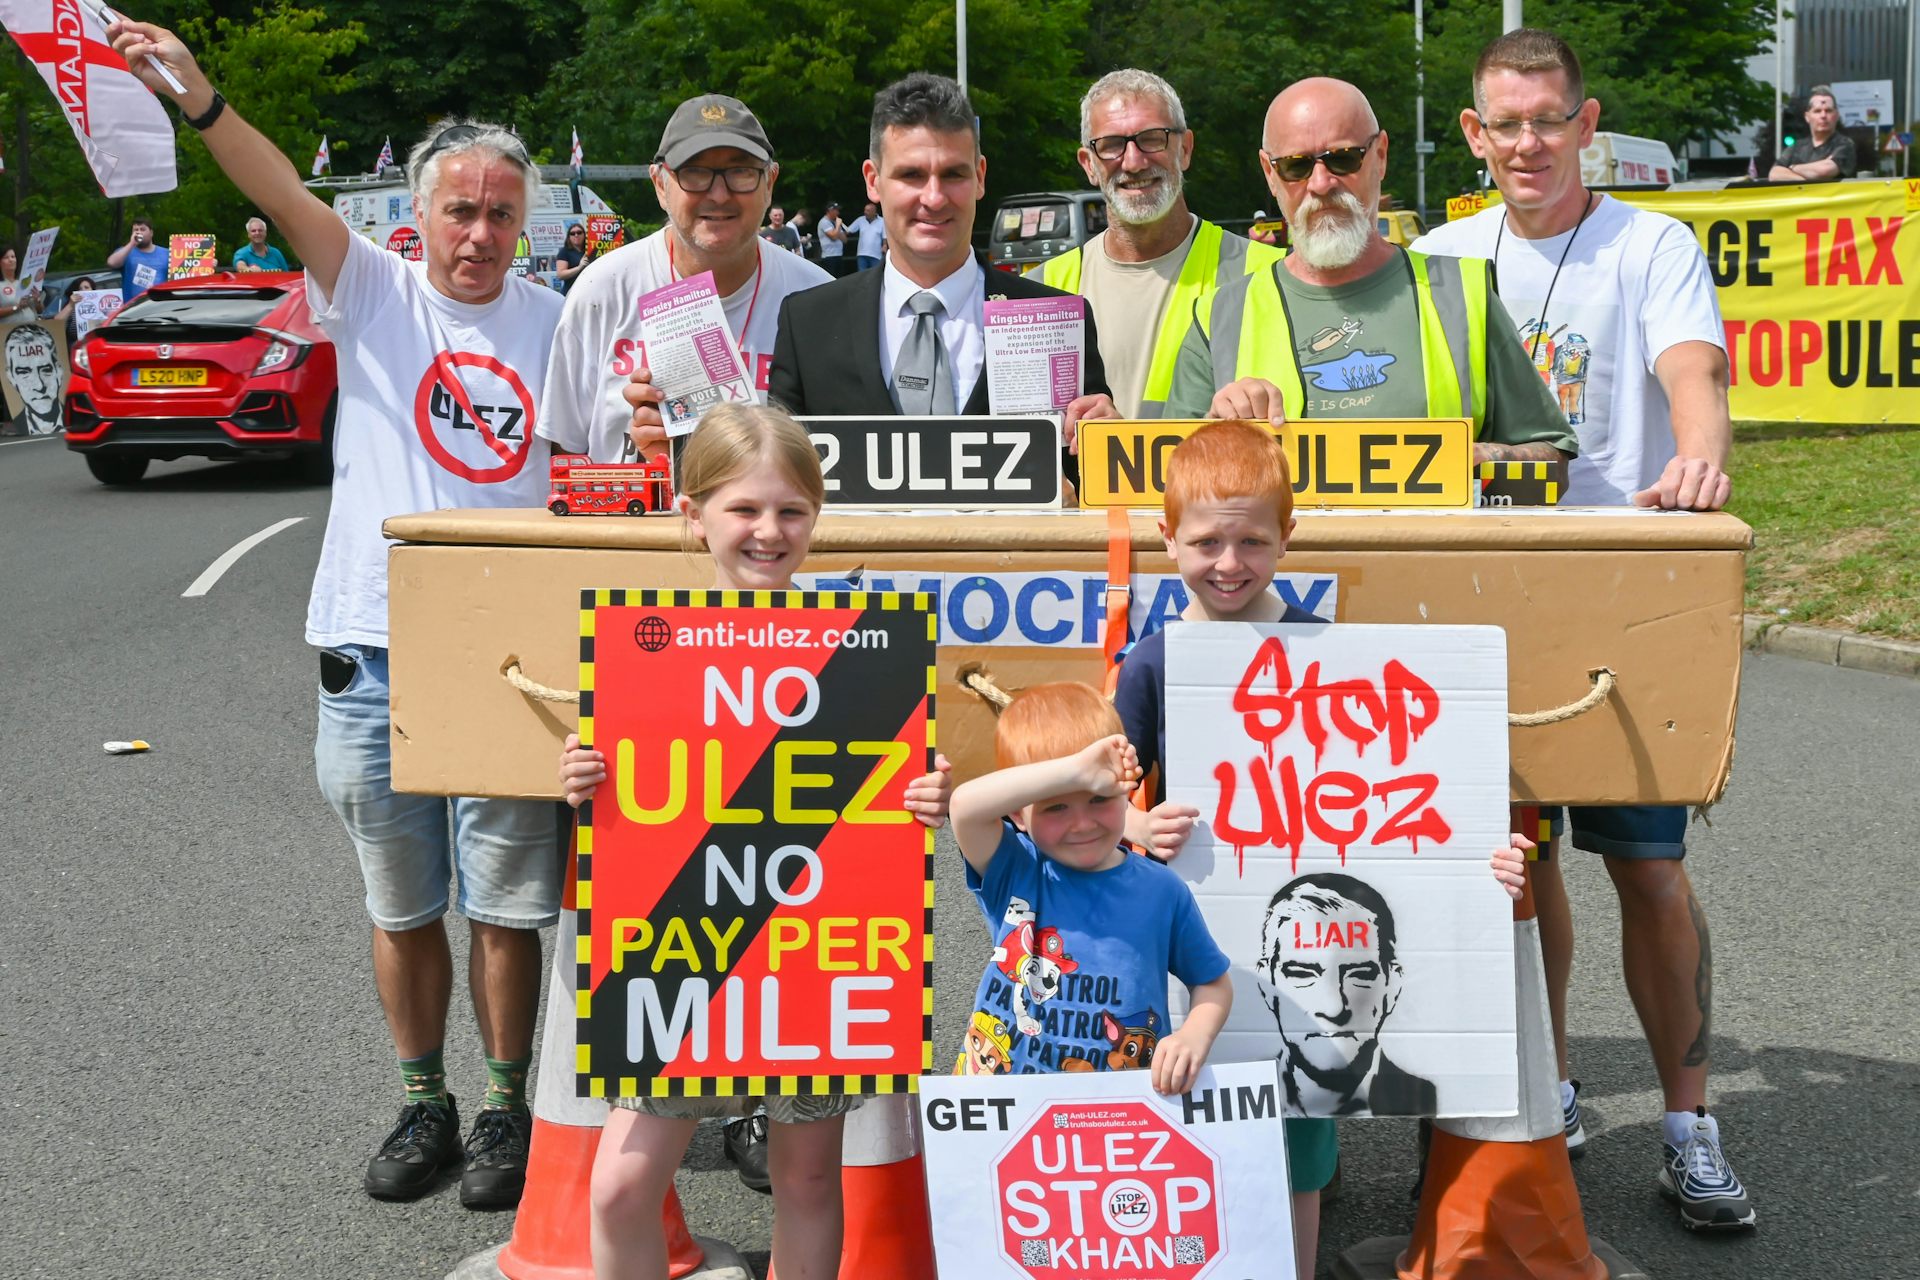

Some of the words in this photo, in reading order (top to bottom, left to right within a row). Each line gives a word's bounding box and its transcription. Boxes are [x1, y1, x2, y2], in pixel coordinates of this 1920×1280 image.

[1450, 197, 1484, 212] VOTE
[590, 222, 621, 232] STOP
[596, 233, 614, 241] THE
[184, 241, 201, 249] NO
[388, 240, 402, 250] NO
[403, 239, 420, 250] PAY
[589, 240, 620, 249] TOXIC
[1796, 216, 1904, 286] TAX
[173, 248, 213, 259] ULEZ
[403, 250, 423, 259] MILE
[184, 259, 201, 267] NO
[511, 257, 530, 266] OUR
[172, 266, 190, 274] PAY
[643, 297, 673, 317] Kingsley
[673, 287, 712, 306] Hamilton
[684, 299, 714, 315] candidate
[693, 317, 704, 326] the
[990, 314, 1035, 326] Kingsley
[1036, 311, 1080, 321] Hamilton
[662, 334, 675, 344] Low
[674, 327, 702, 340] Emission
[703, 321, 718, 330] Zone
[1001, 325, 1046, 334] Independent
[1047, 322, 1079, 331] candidate
[1023, 332, 1053, 341] opposes
[1007, 340, 1044, 348] expansion
[1030, 344, 1061, 354] Emission
[18, 345, 44, 357] LIAR
[140, 369, 174, 382] LS20
[178, 369, 204, 382] HNP
[689, 388, 718, 403] VOTE
[430, 382, 524, 441] ULEZ
[1320, 399, 1336, 411] IS
[865, 431, 1033, 492] ULEZ
[1272, 433, 1443, 494] ULEZ
[575, 495, 593, 506] NO
[675, 621, 889, 650] anti-ulez.com
[703, 665, 820, 727] NO
[616, 738, 915, 825] ULEZ
[705, 844, 824, 906] NO
[1293, 921, 1371, 950] LIAR
[611, 916, 744, 973] PAY
[768, 916, 911, 972] PER
[626, 975, 895, 1063] MILE
[926, 1098, 1016, 1131] GET
[1181, 1084, 1277, 1125] HIM
[1069, 1111, 1128, 1120] Anti-ULEZ.com
[1069, 1119, 1149, 1129] truthaboutulez.co.uk
[1032, 1131, 1175, 1174] ULEZ
[1115, 1193, 1141, 1203] STOP
[1005, 1176, 1211, 1237] STOP
[1111, 1202, 1148, 1215] ULEZ
[1048, 1236, 1175, 1270] KHAN
